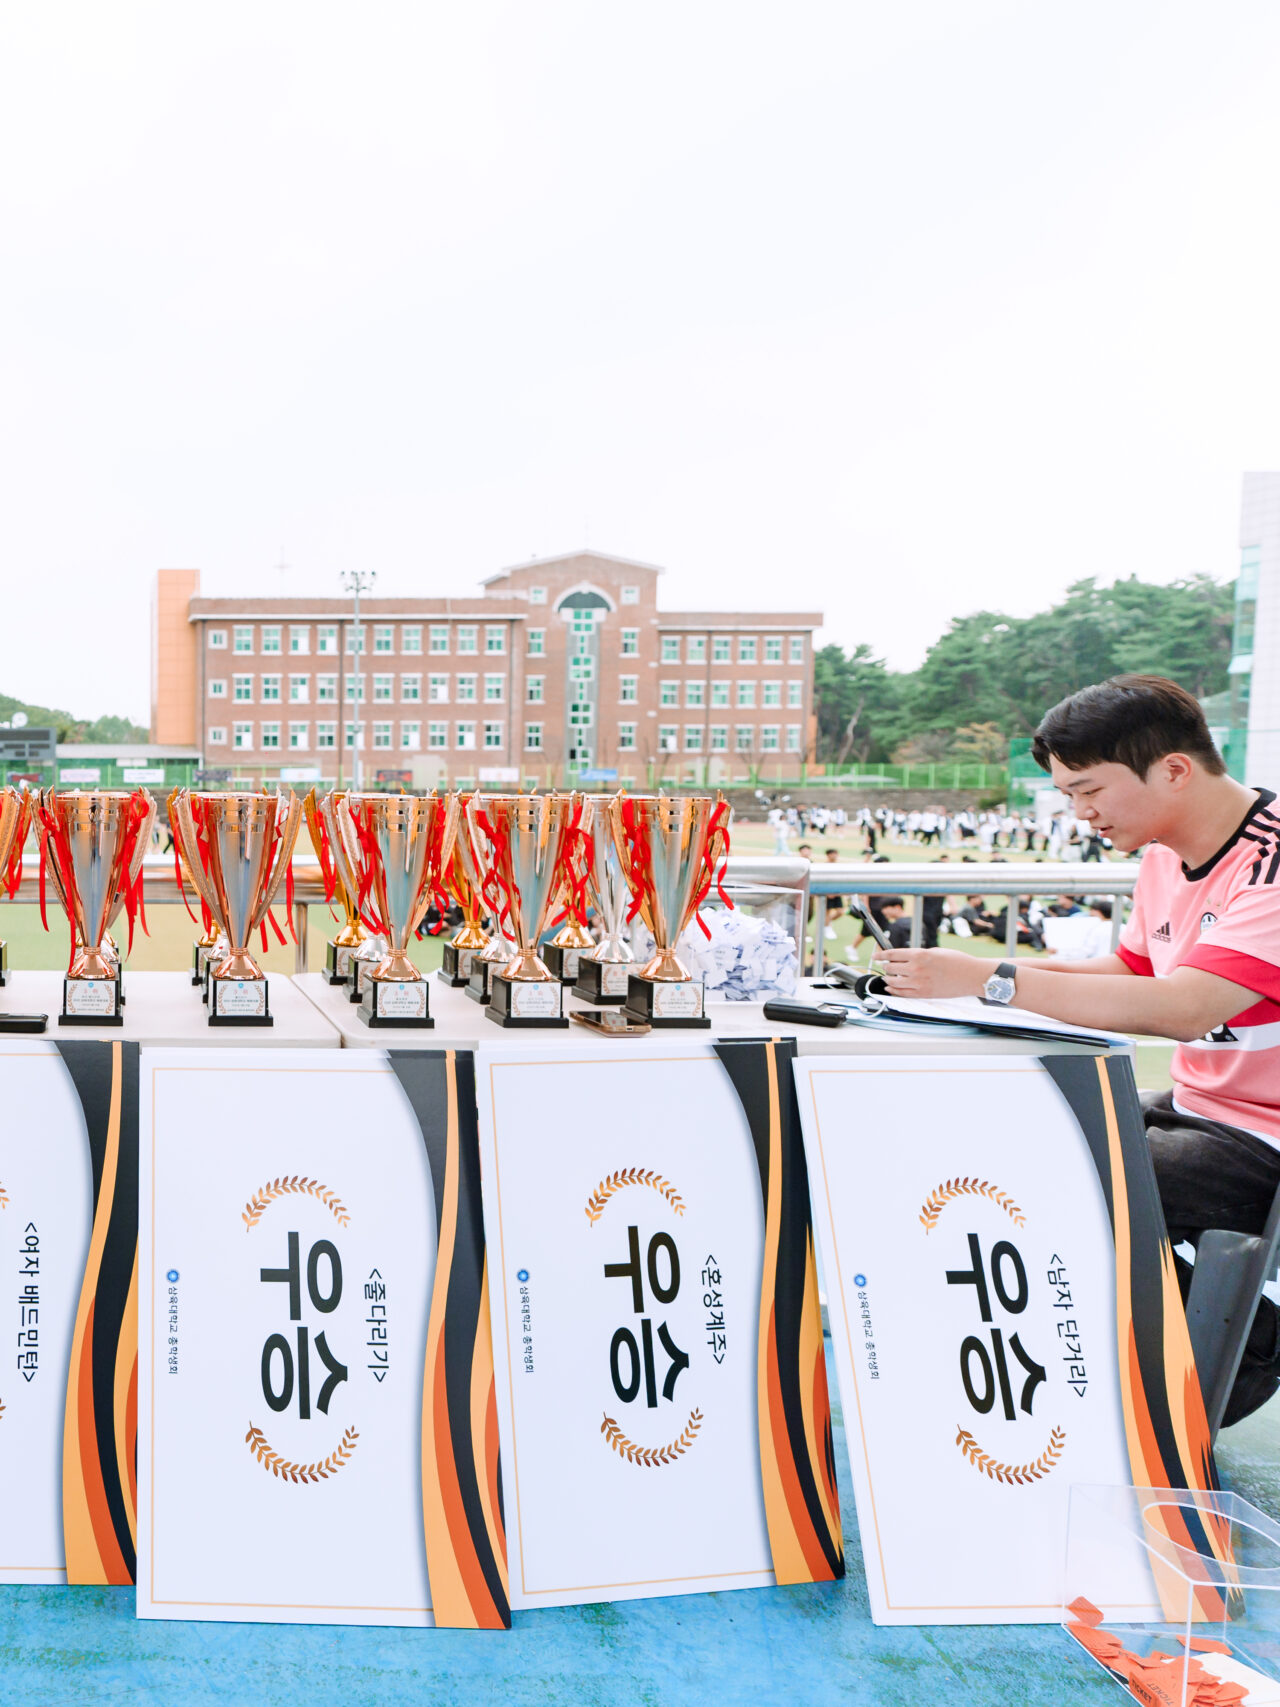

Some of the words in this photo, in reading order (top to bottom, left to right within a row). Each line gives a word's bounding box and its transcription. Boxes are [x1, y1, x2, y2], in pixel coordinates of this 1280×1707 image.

[19, 1222, 40, 1277] <여자
[167, 1286, 179, 1333] 삼육대학교
[519, 1286, 532, 1333] 삼육대학교
[701, 1255, 726, 1364] <혼성계주>
[1047, 1254, 1074, 1310] <남자
[18, 1285, 39, 1382] 배드민턴>
[260, 1232, 348, 1420] 우승
[364, 1269, 389, 1383] <줄다리기>
[603, 1225, 690, 1408] 우승
[857, 1291, 874, 1338] 삼육대학교
[945, 1233, 1047, 1420] 우승
[167, 1336, 179, 1374] 총학생회
[522, 1336, 535, 1373] 총학생회
[864, 1341, 881, 1379] 총학생회
[1057, 1320, 1088, 1397] 단거리>
